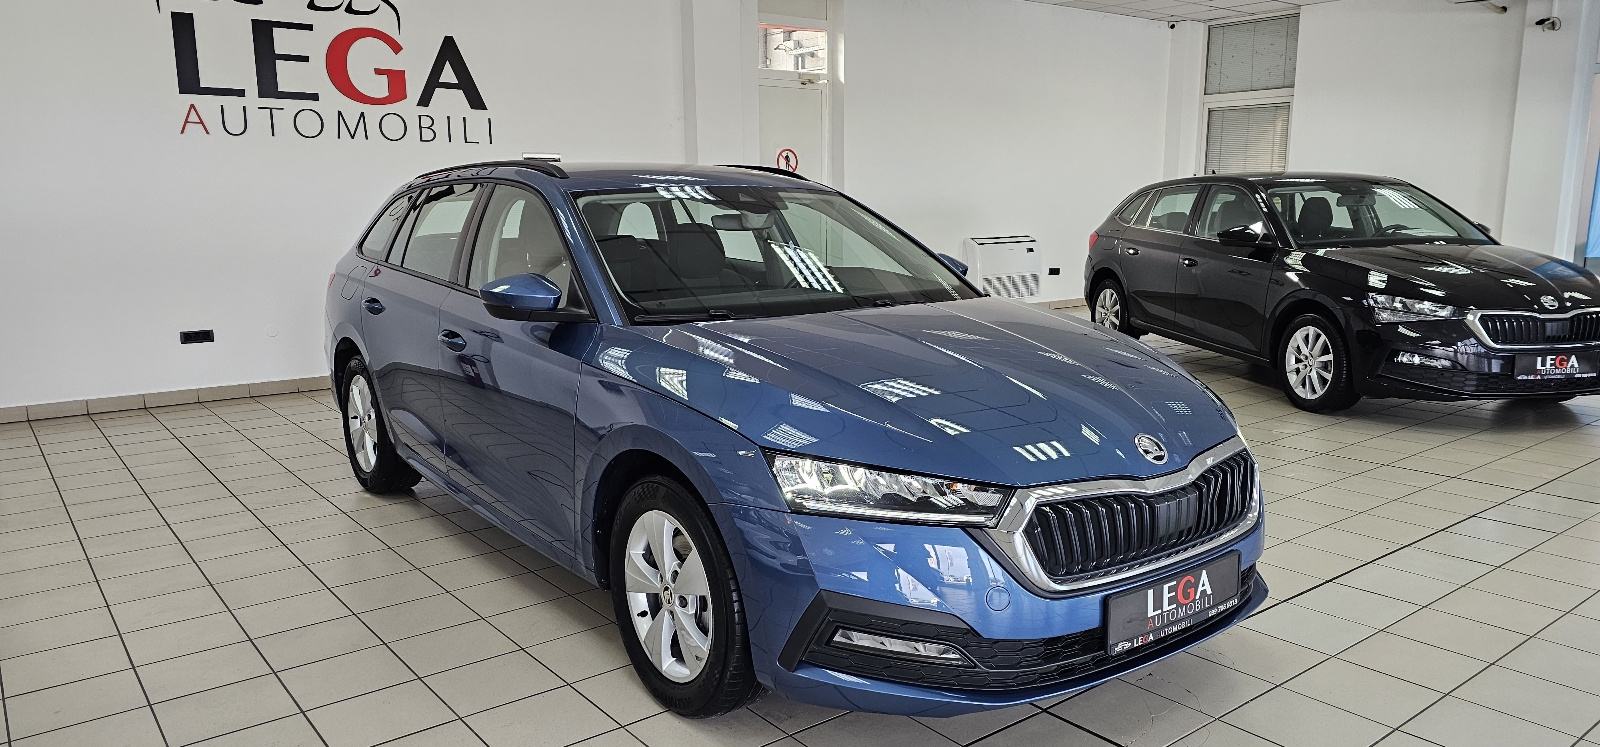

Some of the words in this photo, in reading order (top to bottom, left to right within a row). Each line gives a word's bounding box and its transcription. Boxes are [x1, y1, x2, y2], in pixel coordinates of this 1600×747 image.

[171, 11, 488, 110] LEGA
[180, 103, 493, 145] AUTOMOBILI
[1536, 354, 1579, 369] LEGA
[1537, 367, 1579, 375] AUTOMOBILI
[1147, 569, 1212, 617] LEGA
[1147, 594, 1213, 629] AUTOMOBILI
[1133, 633, 1154, 648] LEGA
